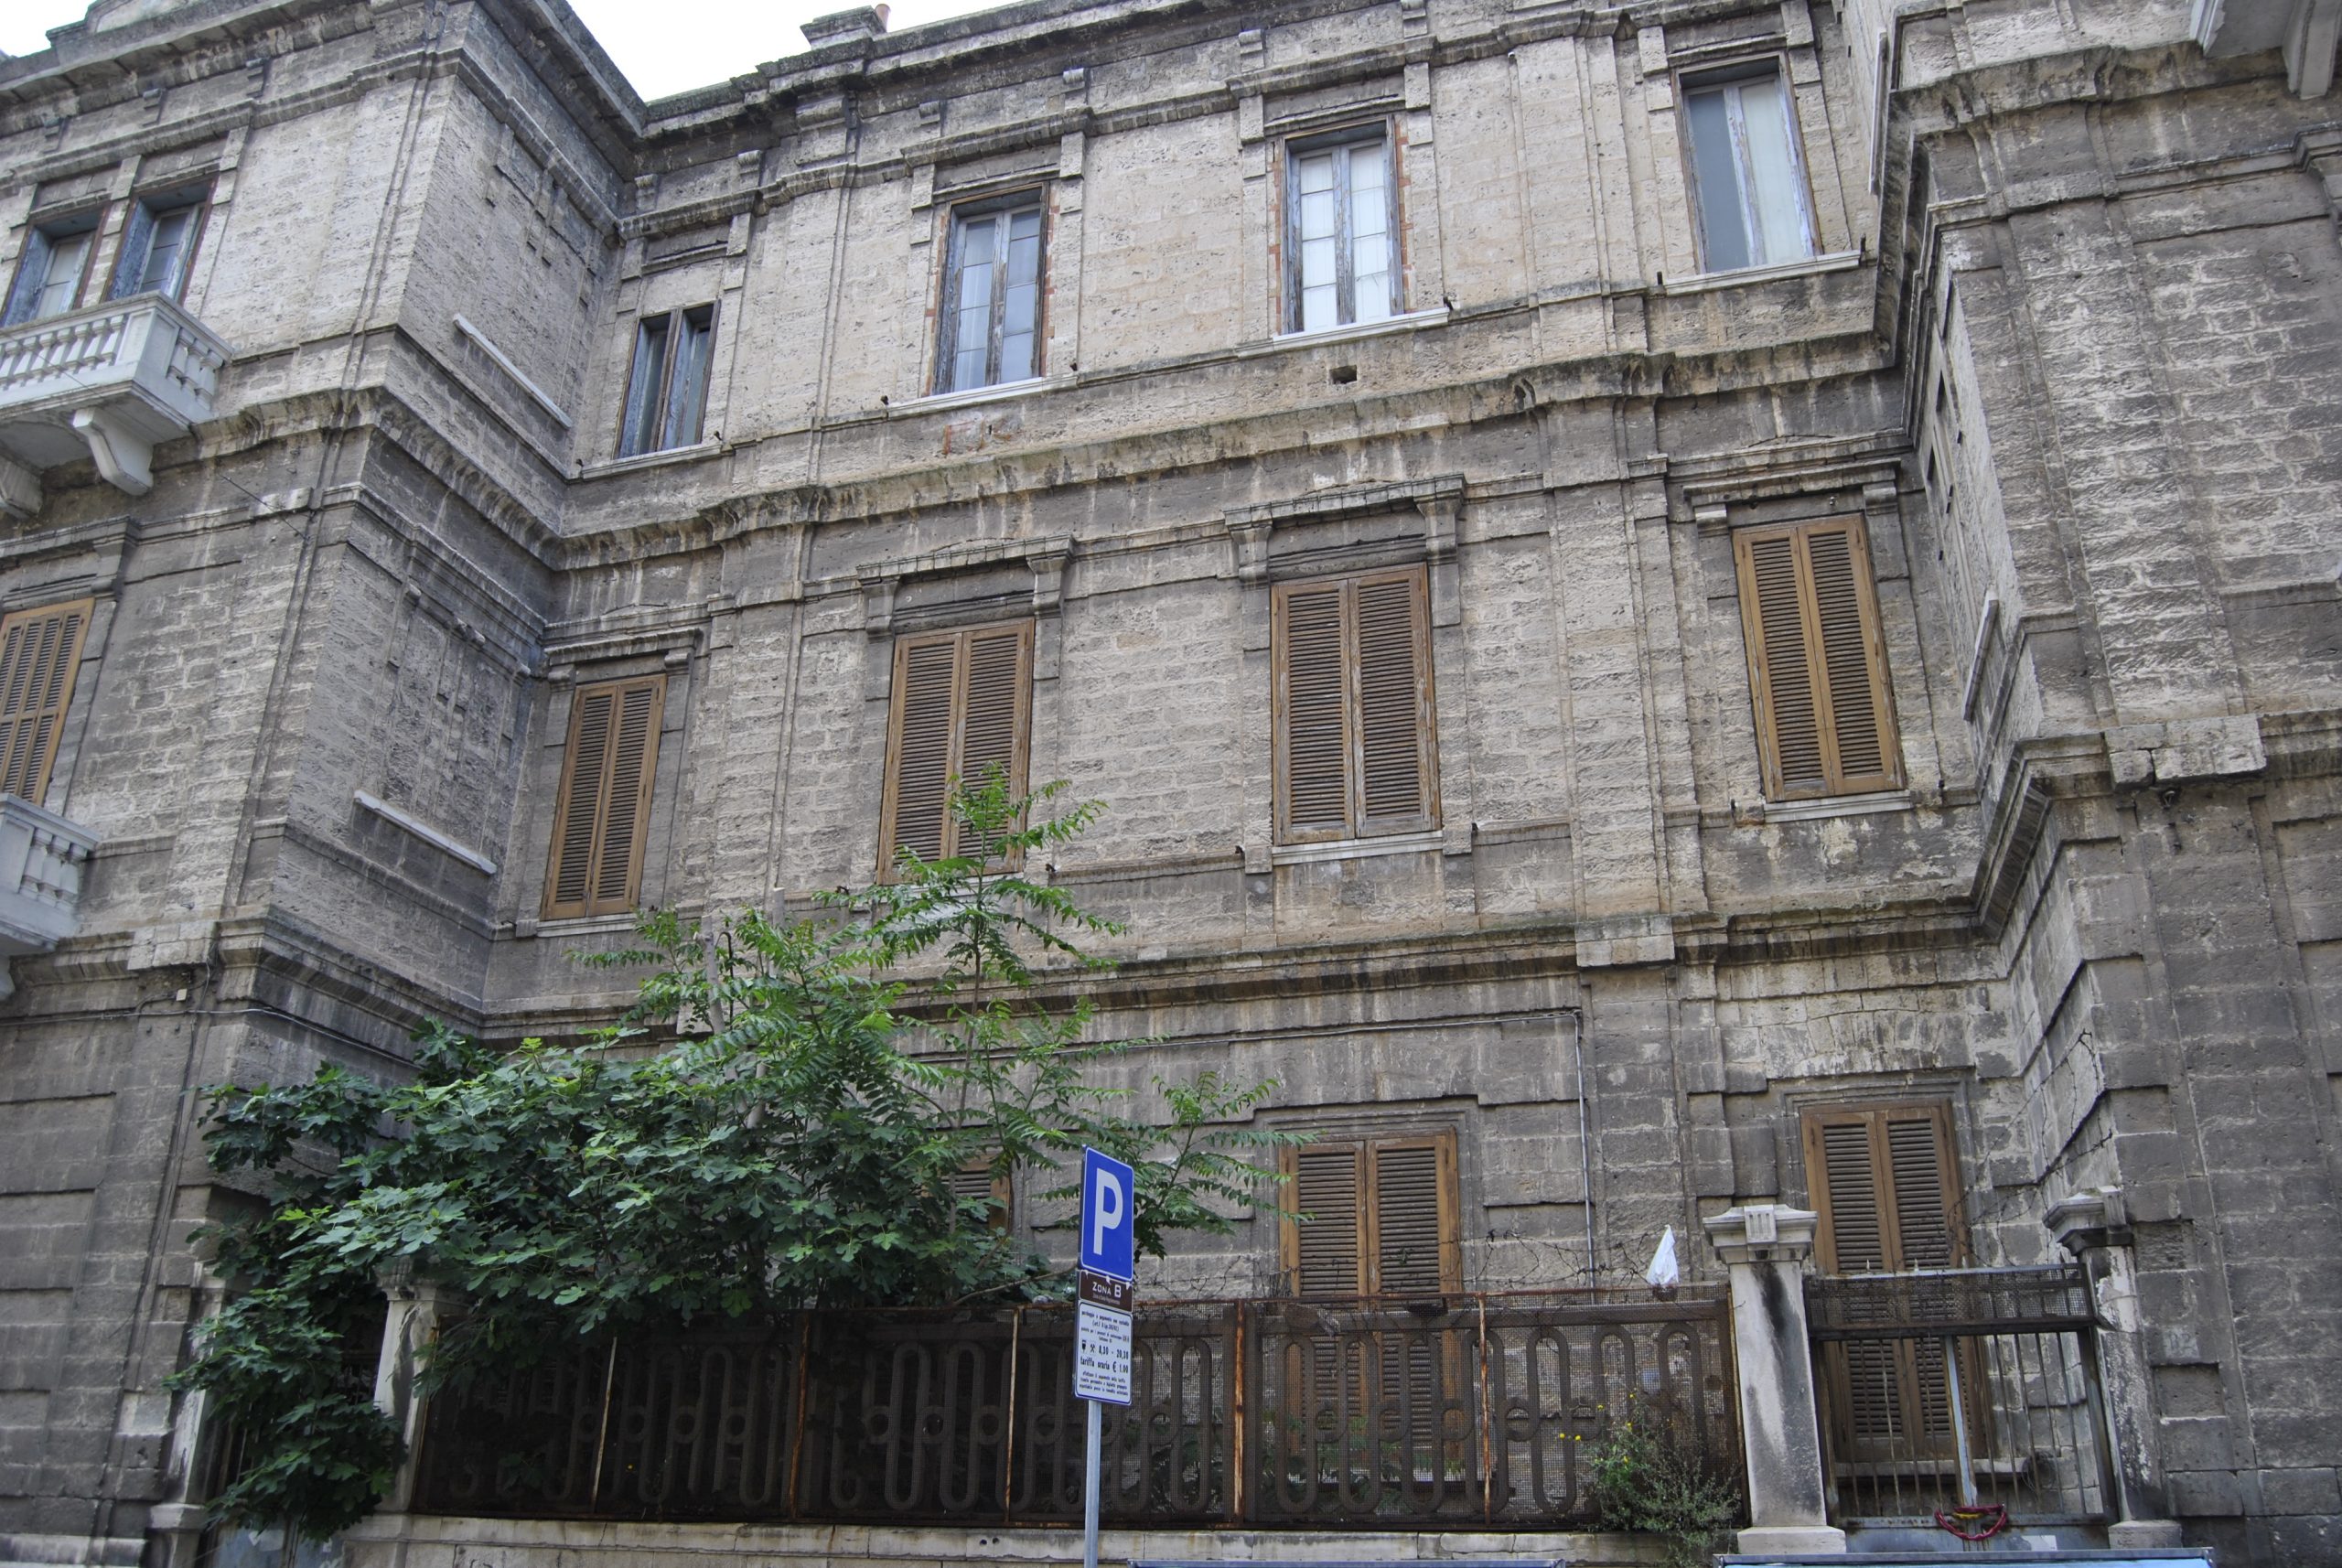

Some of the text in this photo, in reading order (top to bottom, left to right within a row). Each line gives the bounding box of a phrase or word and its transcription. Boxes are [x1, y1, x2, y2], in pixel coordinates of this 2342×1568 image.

[1093, 1167, 1123, 1255] P
[1092, 1282, 1122, 1298] ZONA B
[1080, 1356, 1095, 1368] tariffa
[1112, 1360, 1117, 1373] €
